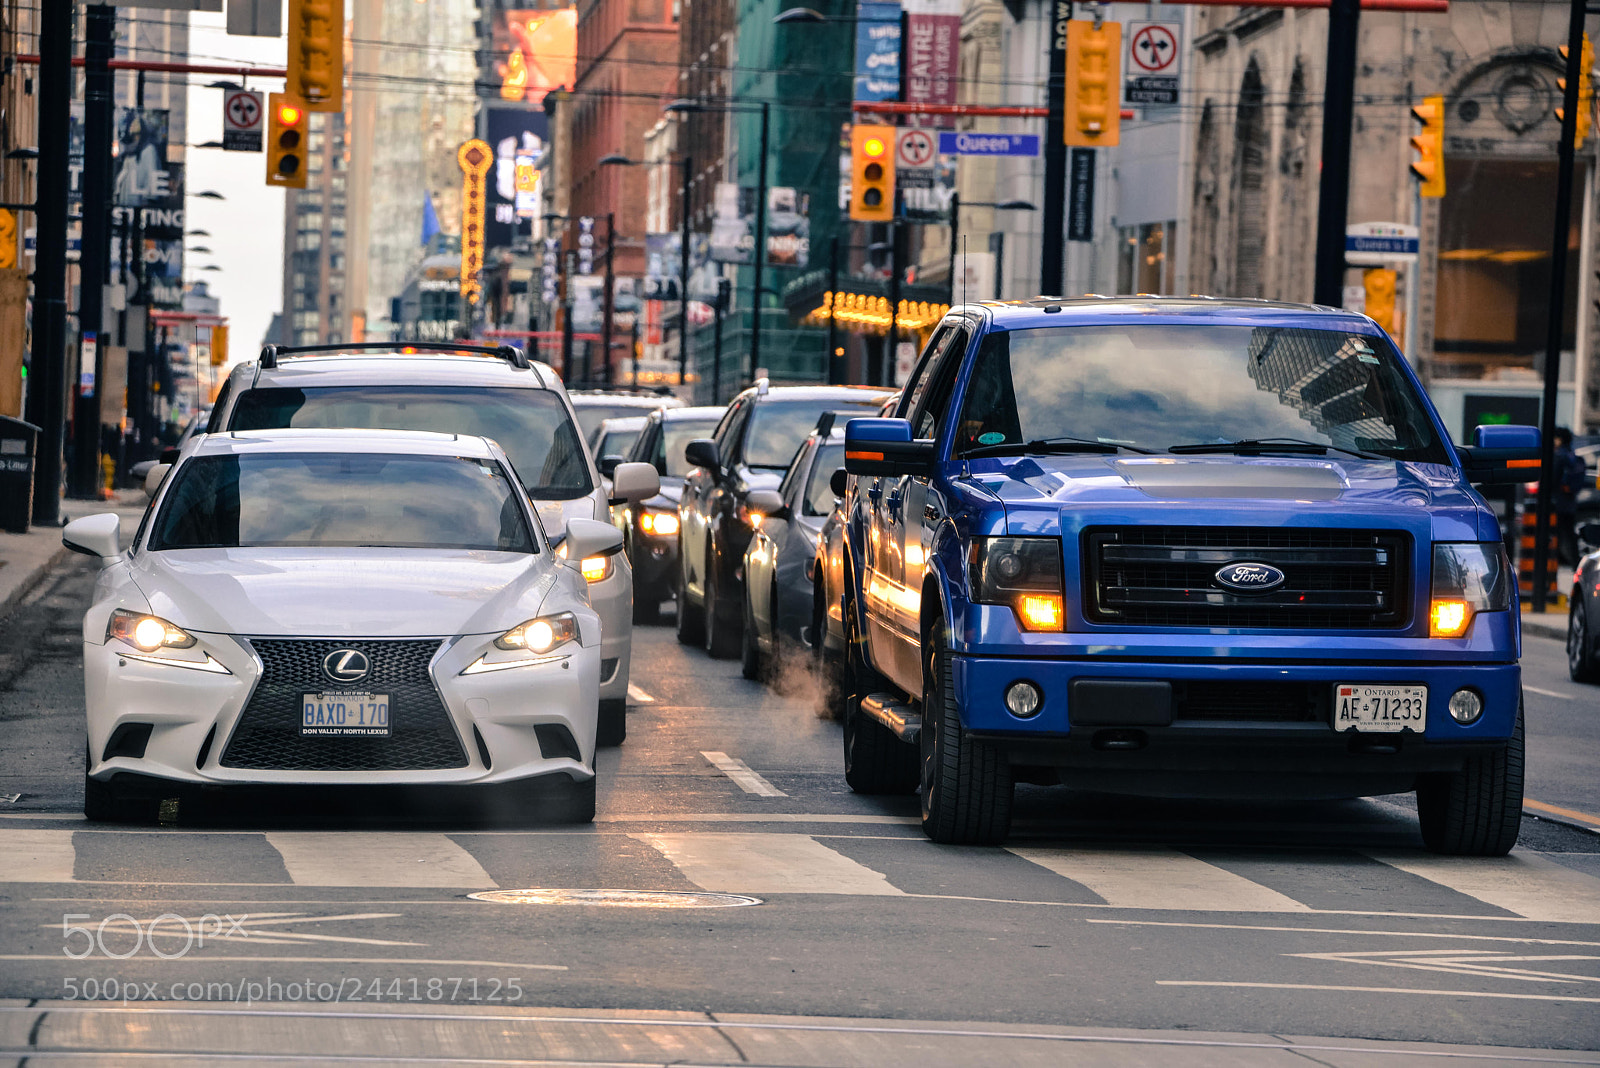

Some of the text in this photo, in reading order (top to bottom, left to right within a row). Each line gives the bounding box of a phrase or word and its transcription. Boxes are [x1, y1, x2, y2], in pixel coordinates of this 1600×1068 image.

[955, 134, 1010, 152] Queen
[1231, 566, 1270, 583] Ford
[1364, 688, 1400, 697] ONTARIO
[305, 703, 388, 725] BAXD 170
[1340, 697, 1423, 720] AE 71233
